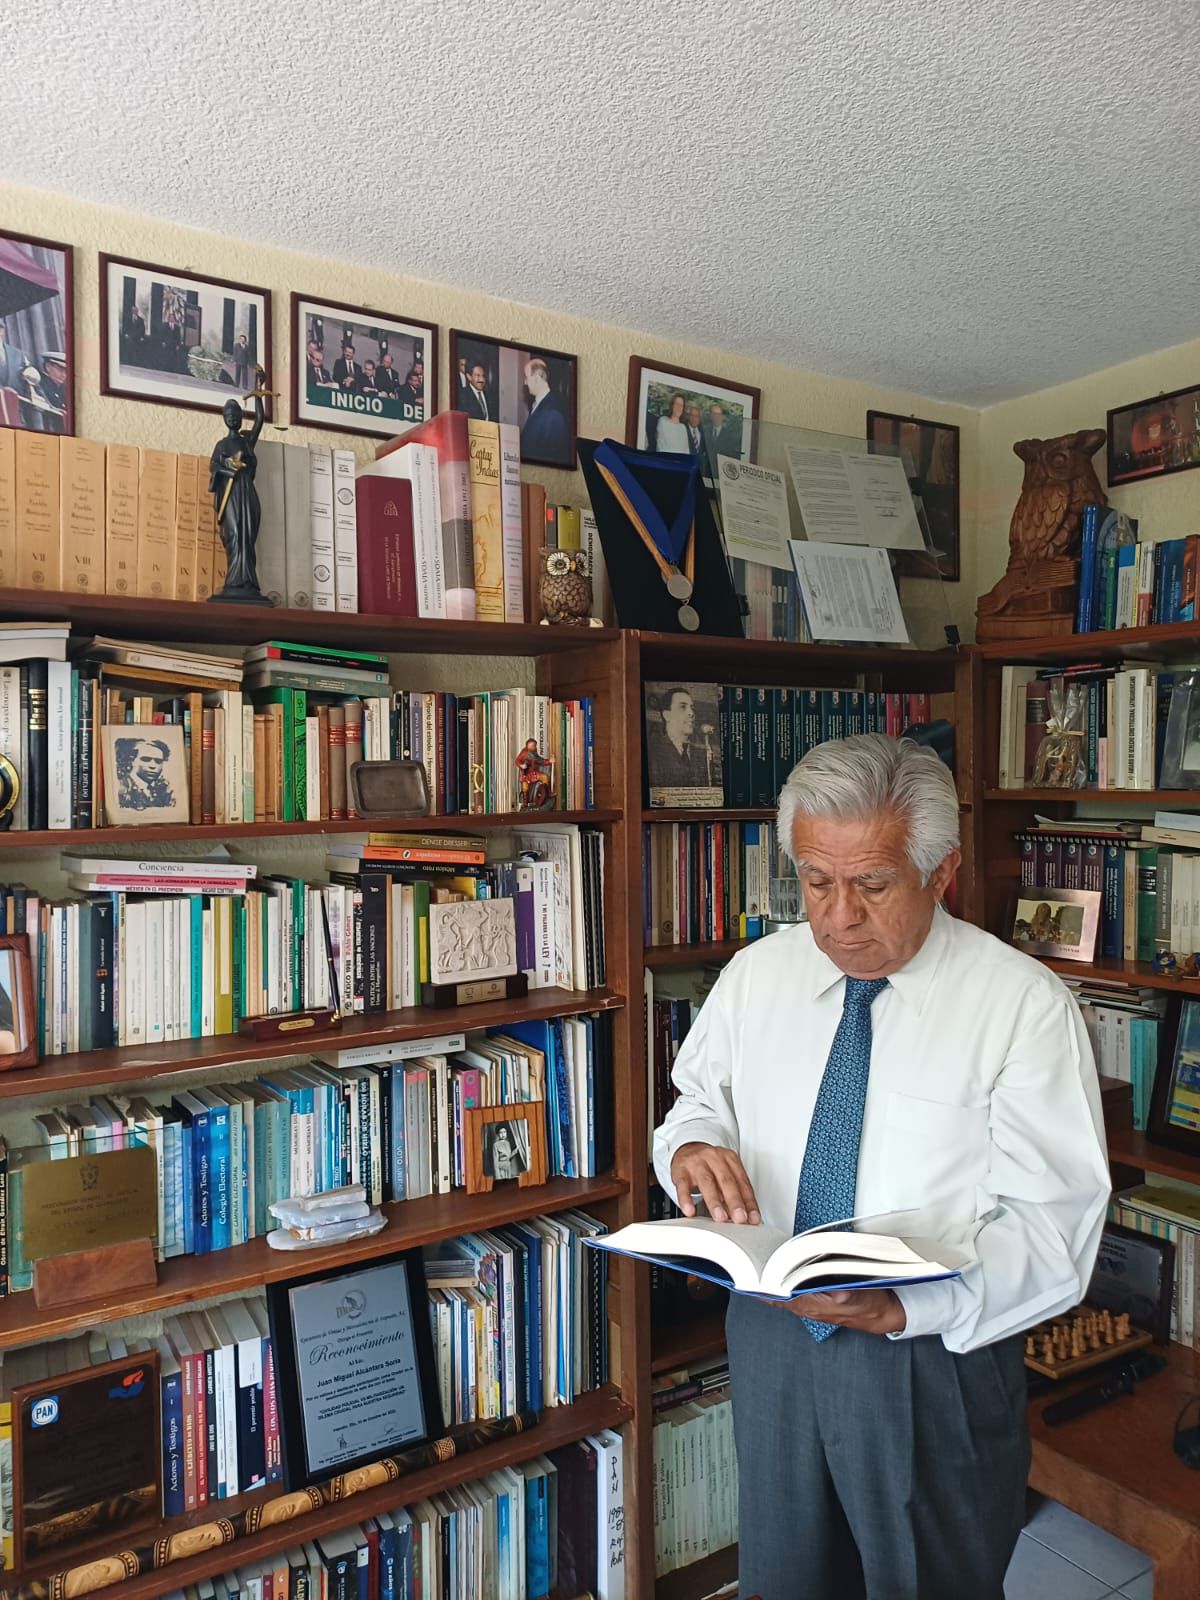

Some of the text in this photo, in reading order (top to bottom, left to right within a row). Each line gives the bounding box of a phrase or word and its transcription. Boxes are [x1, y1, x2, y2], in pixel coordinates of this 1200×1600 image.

[331, 391, 424, 421] INICIO DE
[32, 552, 46, 562] VII
[75, 555, 91, 565] VIII
[138, 862, 185, 873] Conciencia
[542, 946, 550, 959] LEY
[199, 1155, 209, 1189] Testigos
[218, 1156, 228, 1226] Colegio Electoral
[200, 1197, 208, 1228] Actores
[309, 1330, 404, 1366] Reconocimiento
[317, 1379, 332, 1388] Juan
[334, 1371, 354, 1383] Miguel
[385, 1358, 401, 1368] Soria
[37, 1404, 54, 1420] PAN
[169, 1418, 179, 1452] Testigos
[169, 1460, 178, 1492] Actores
